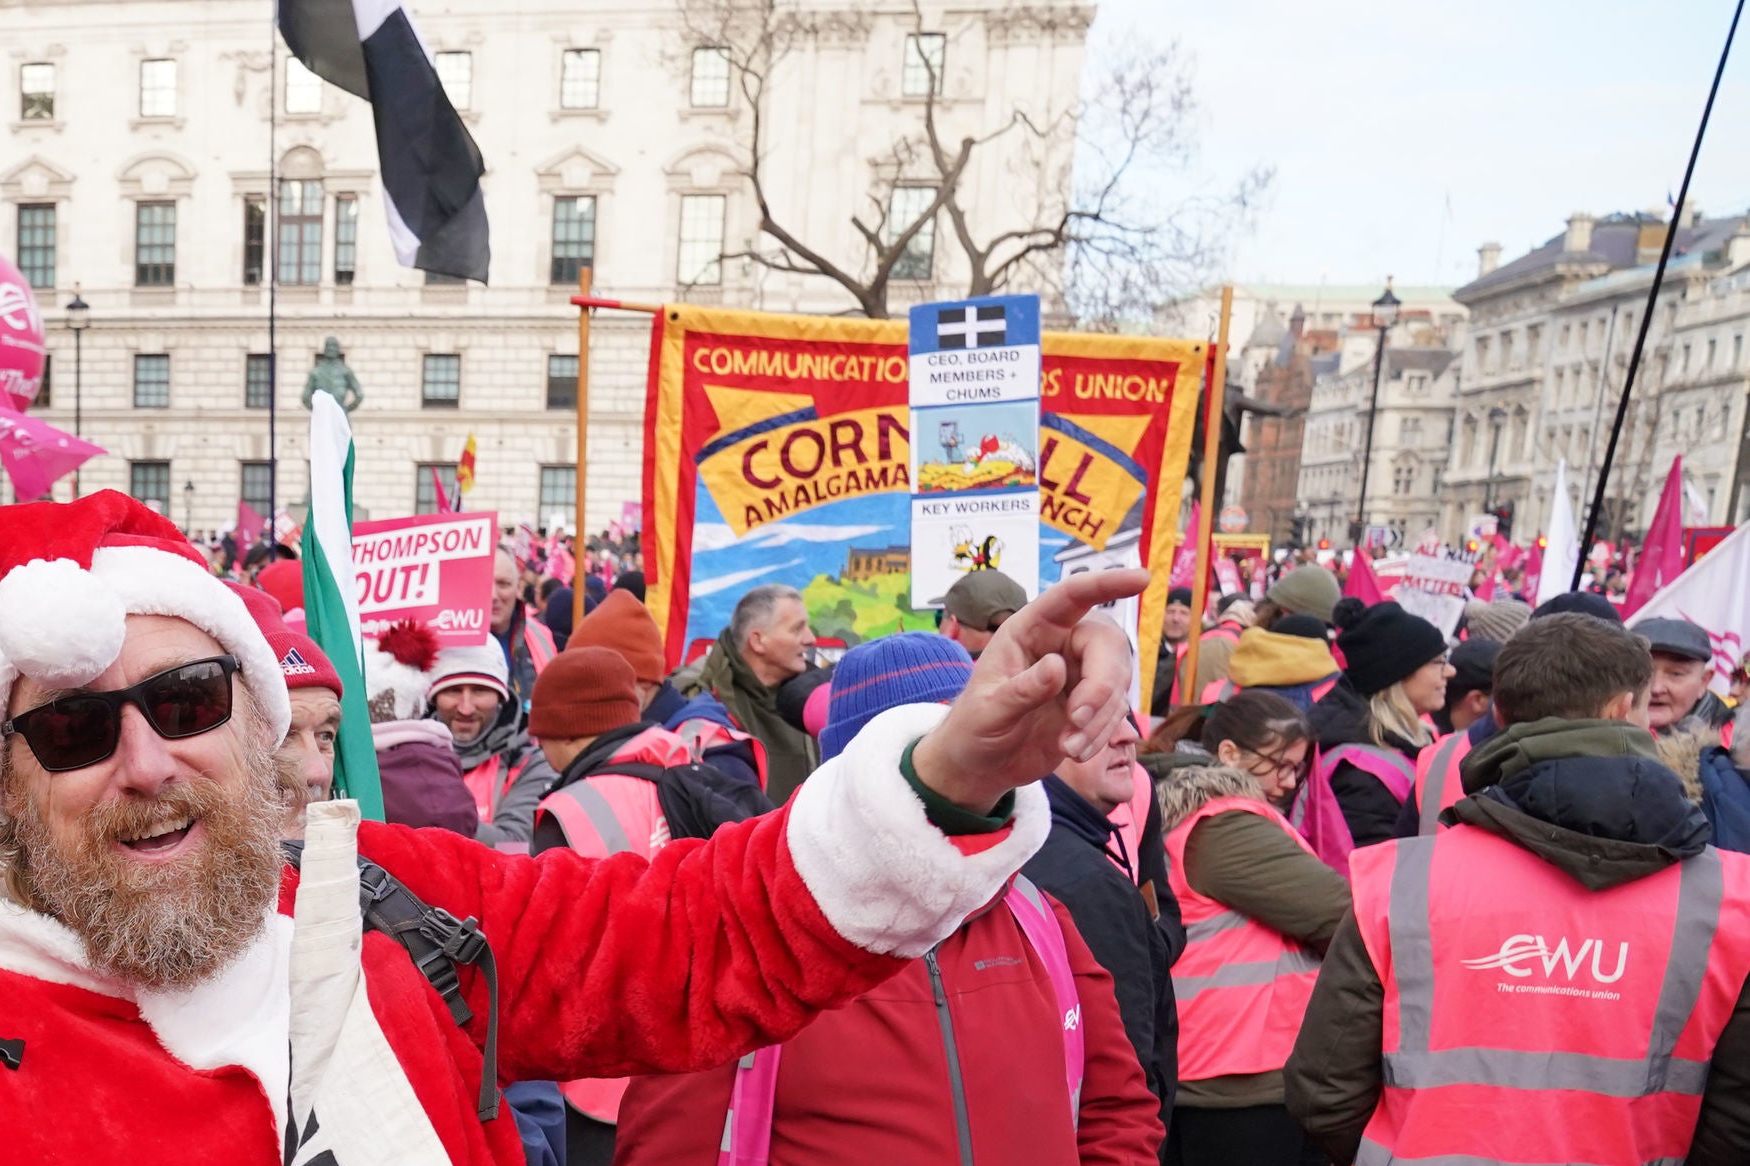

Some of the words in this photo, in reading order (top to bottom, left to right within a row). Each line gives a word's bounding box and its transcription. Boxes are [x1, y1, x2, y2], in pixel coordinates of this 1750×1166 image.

[928, 354, 963, 366] CEO,
[967, 350, 1020, 364] BOARD
[693, 347, 909, 384] COMMUNICATIO
[1075, 372, 1169, 403] UNION
[930, 369, 1005, 383] MEMBERS
[946, 387, 1001, 401] CHUMS
[744, 463, 909, 528] AMALGAMA
[922, 503, 953, 515] KEY
[956, 499, 1030, 513] WORKERS
[351, 527, 482, 565] THOMPSON
[356, 563, 429, 605] OUT!
[435, 608, 484, 630] CWU
[1499, 934, 1629, 984] CWU
[1498, 982, 1514, 993] The
[1516, 984, 1590, 998] communications
[1592, 991, 1620, 1001] union
